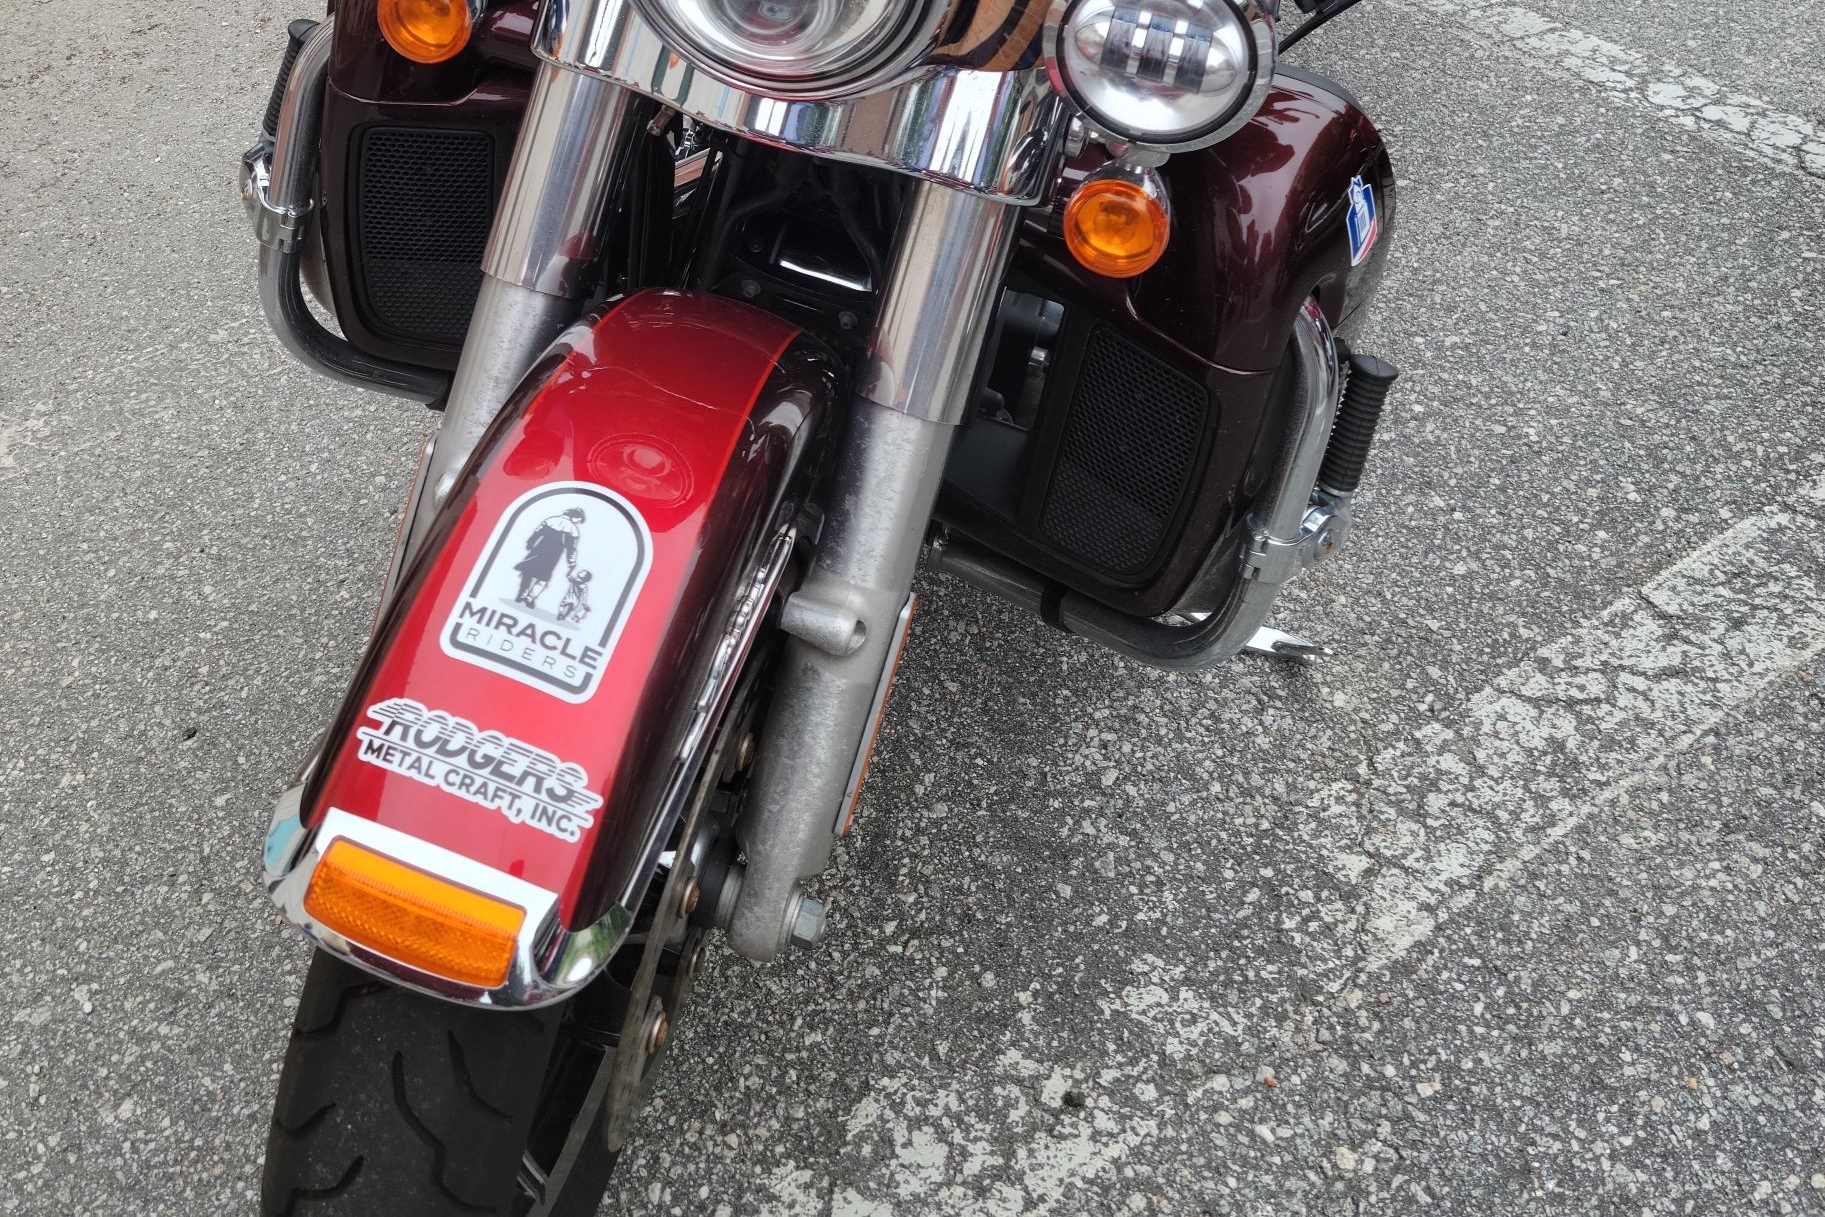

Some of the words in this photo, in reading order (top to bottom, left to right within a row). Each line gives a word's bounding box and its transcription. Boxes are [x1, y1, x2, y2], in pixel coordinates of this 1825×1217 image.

[458, 600, 603, 671] MIRACLE
[466, 626, 577, 679] RIDERS
[364, 738, 437, 781] METAL
[443, 768, 523, 819] CRAFT,
[530, 801, 577, 837] INC.
[376, 702, 592, 806] RODGERS
